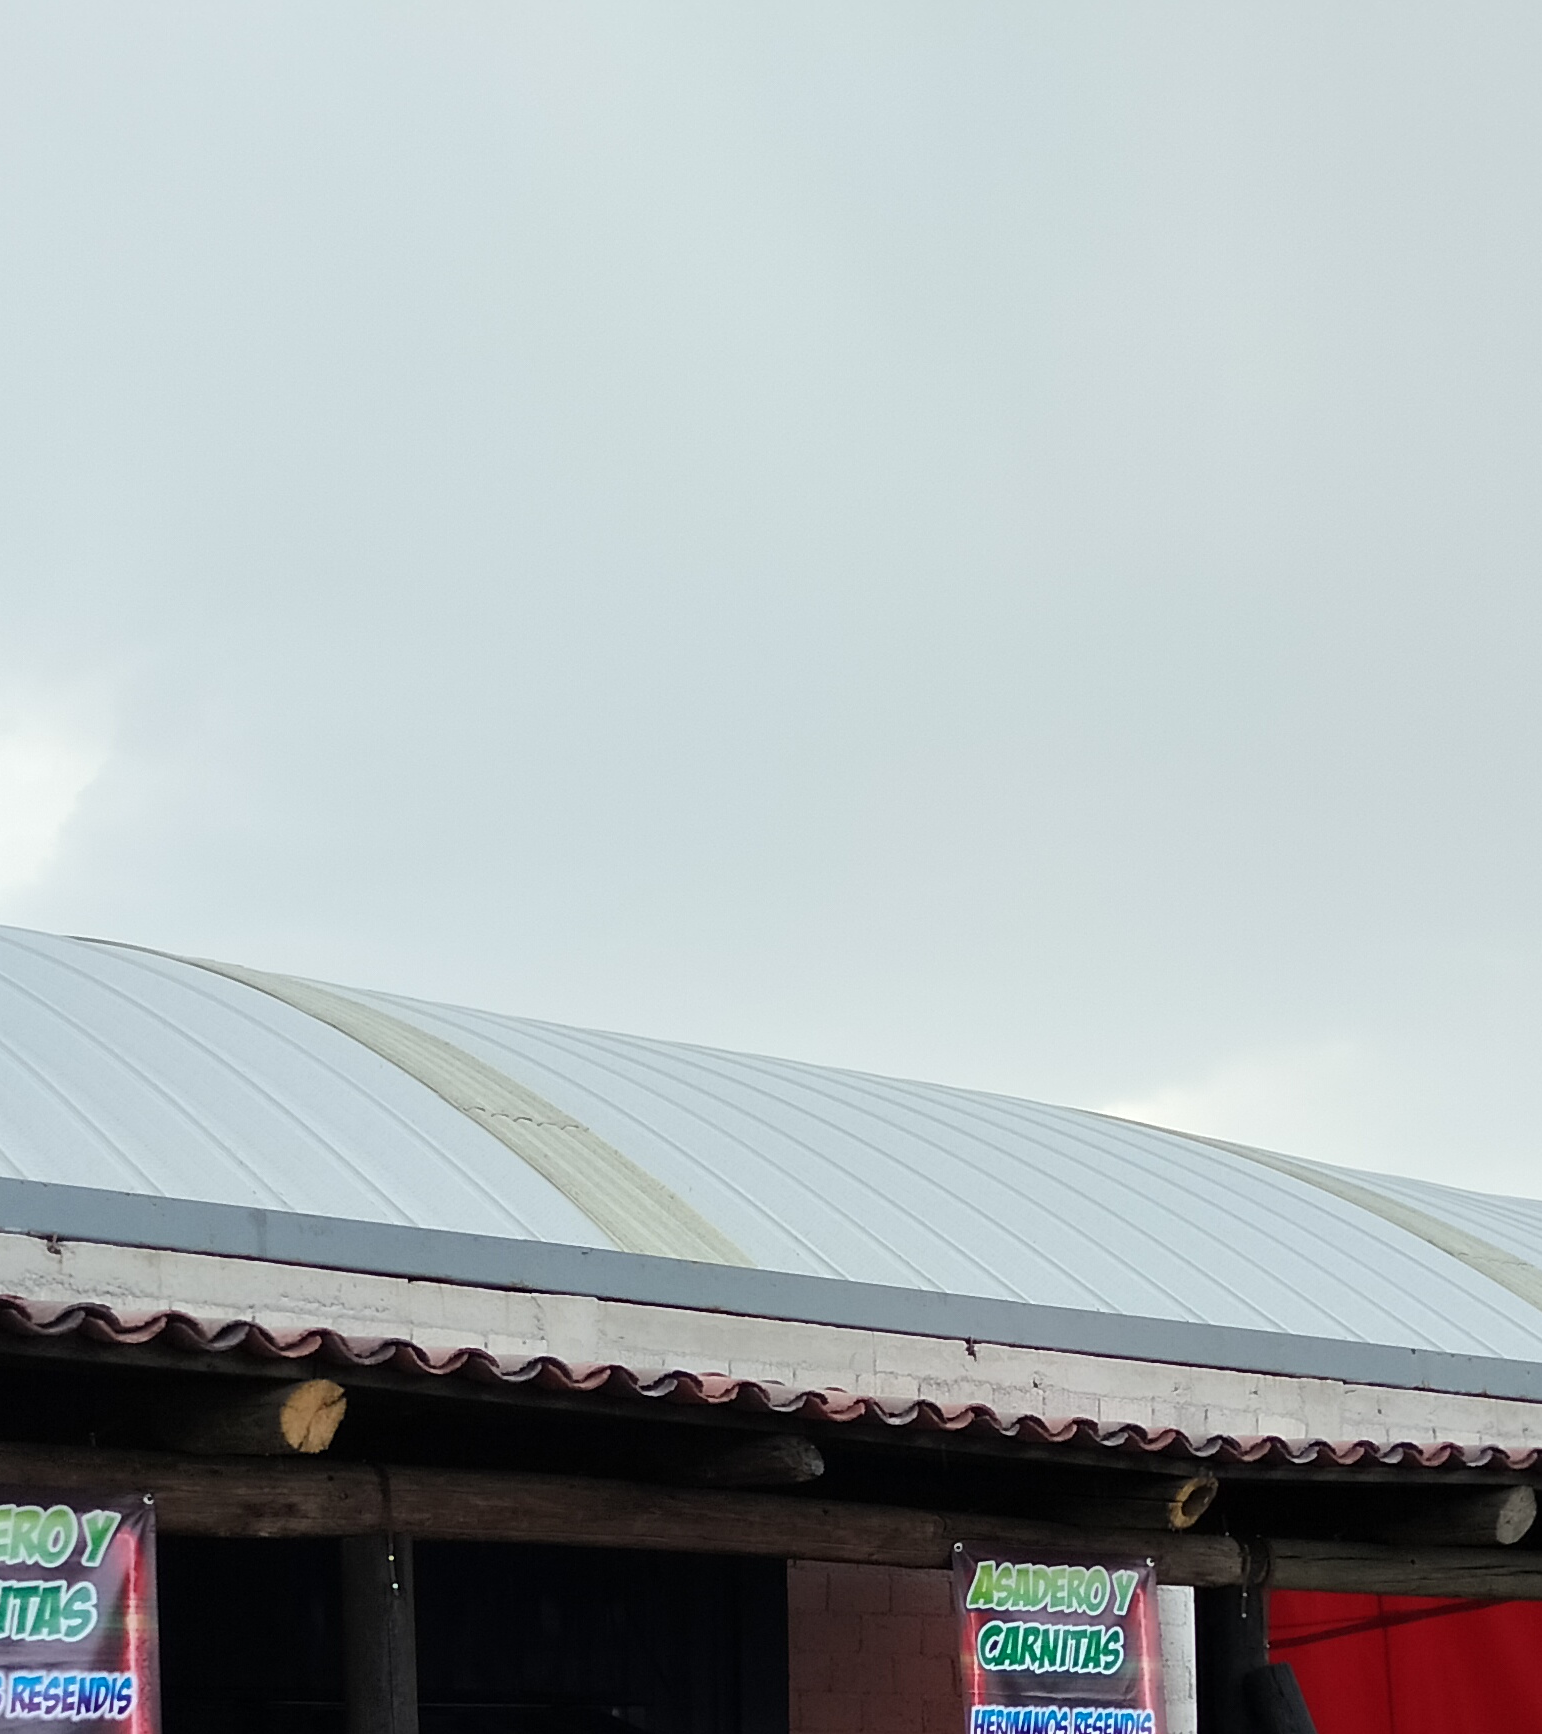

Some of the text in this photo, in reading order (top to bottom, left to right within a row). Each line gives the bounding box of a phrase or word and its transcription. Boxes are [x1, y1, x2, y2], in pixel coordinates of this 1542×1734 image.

[82, 1510, 121, 1567] Y
[966, 1560, 1138, 1616] ASADERO Y
[977, 1621, 1124, 1675] CARNITAS
[4, 1671, 137, 1721] RESENDIS
